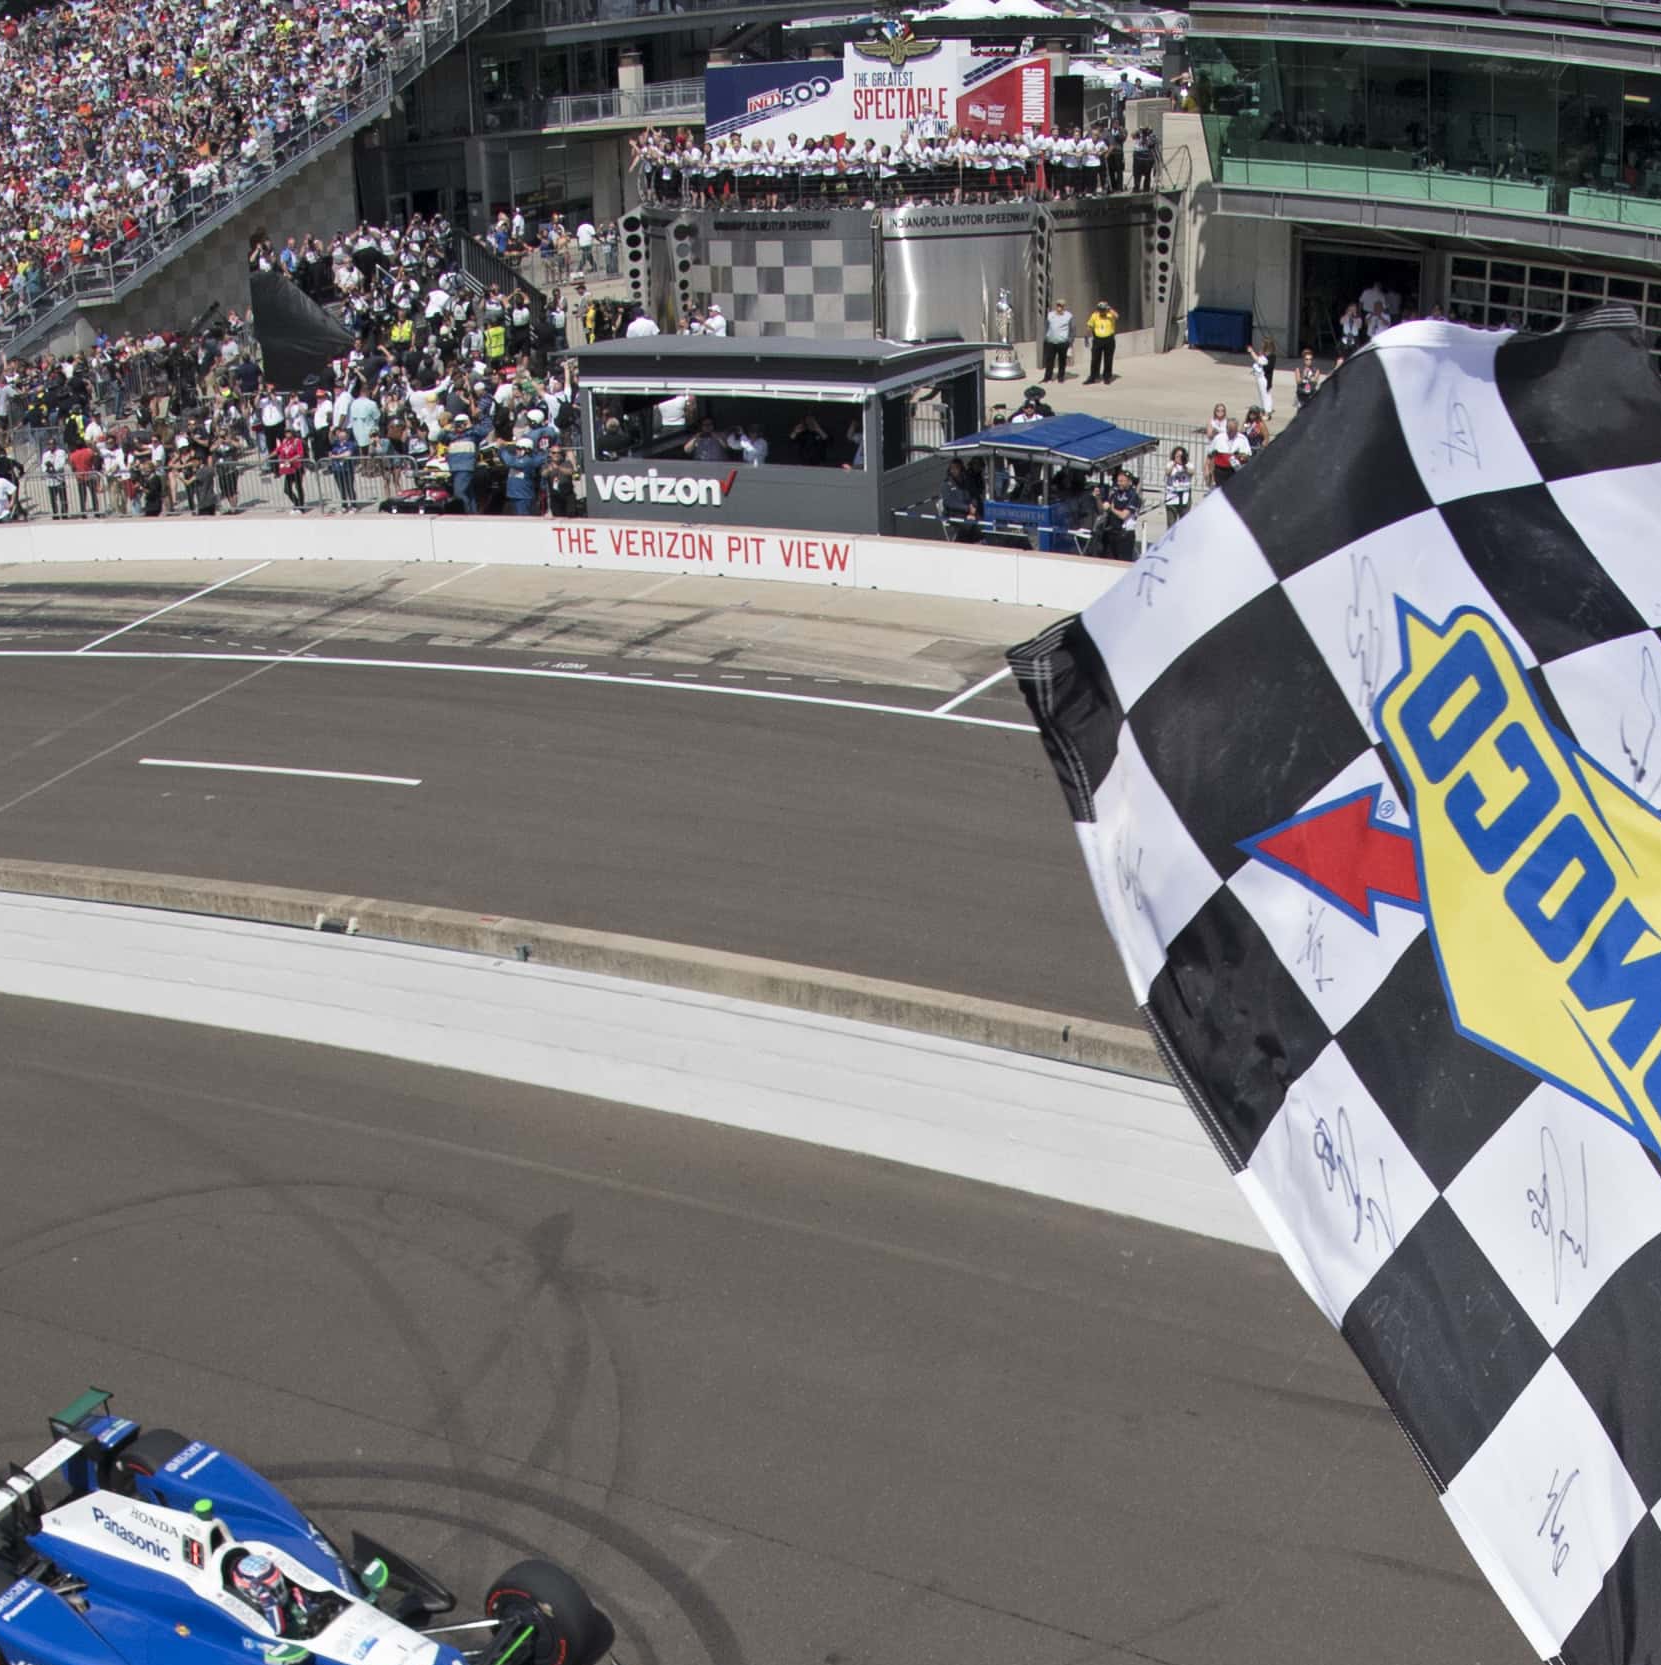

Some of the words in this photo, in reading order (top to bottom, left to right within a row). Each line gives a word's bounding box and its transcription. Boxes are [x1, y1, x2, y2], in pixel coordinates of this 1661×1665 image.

[782, 75, 831, 106] 500
[853, 73, 869, 87] THE
[872, 72, 913, 87] GREATEST
[1022, 68, 1045, 122] RUNNING
[952, 214, 983, 227] MOTOR
[985, 212, 1030, 226] SPEEDWAY
[594, 468, 722, 507] verizon
[552, 527, 597, 555] THE
[609, 528, 713, 562] VERIZON
[728, 536, 766, 565] PIT
[780, 539, 850, 572] VIEW
[92, 1505, 172, 1562] Panasonic
[129, 1506, 180, 1539] HONDA
